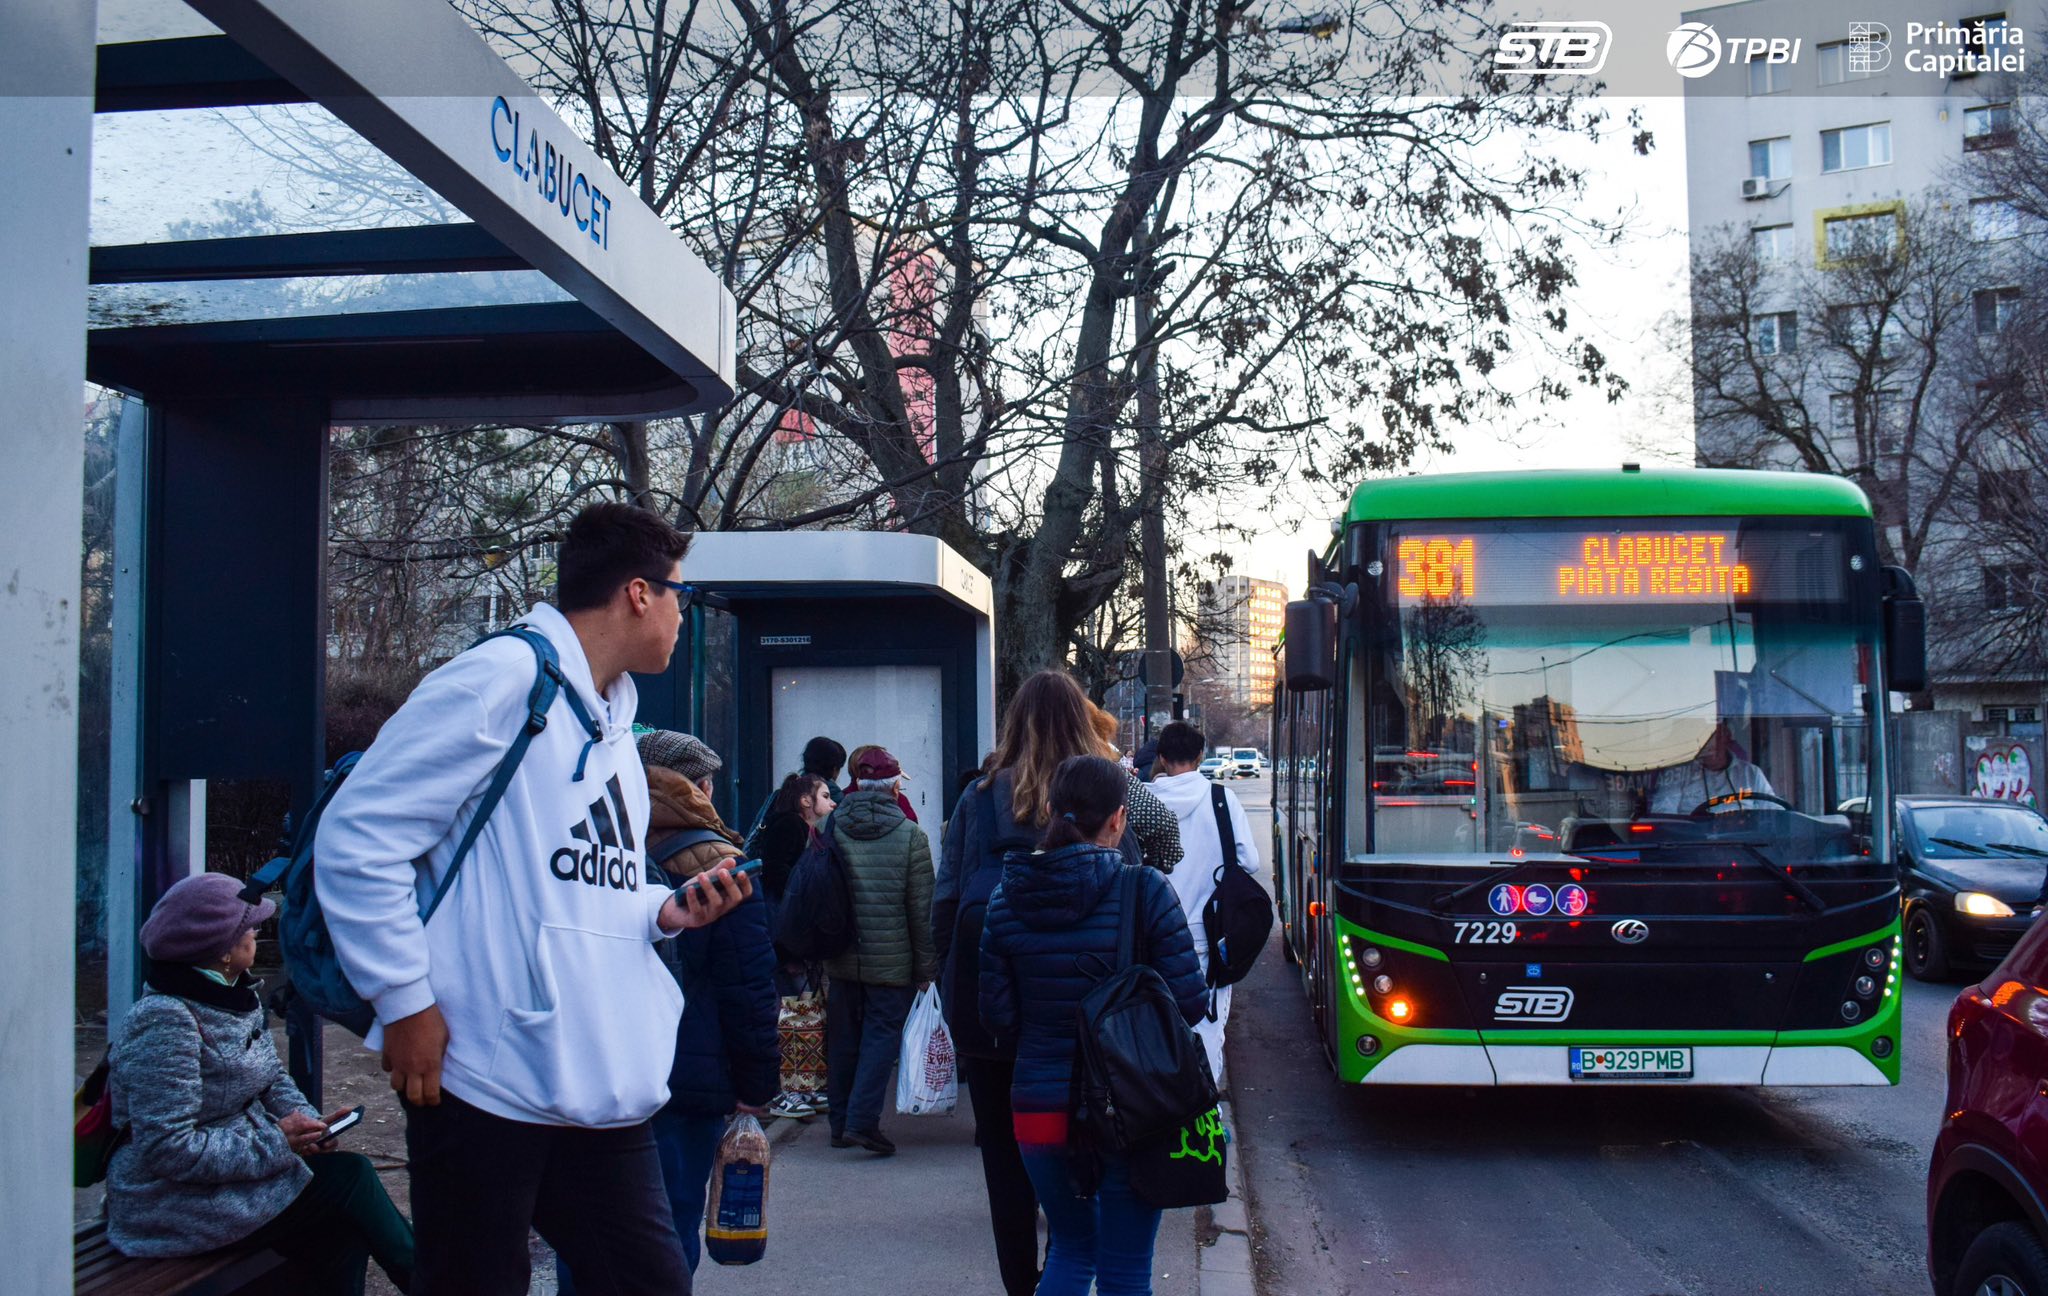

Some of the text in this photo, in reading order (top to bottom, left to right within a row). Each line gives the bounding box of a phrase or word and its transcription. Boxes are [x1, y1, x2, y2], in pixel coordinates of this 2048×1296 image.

[491, 95, 611, 251] CLABUCET
[1583, 536, 1725, 565] CLABUCET
[1398, 539, 1475, 597] 381
[1558, 565, 1750, 595] PIATA RESITA
[549, 843, 638, 892] adida
[1453, 922, 1517, 944] 7229
[1494, 992, 1567, 1015] STB
